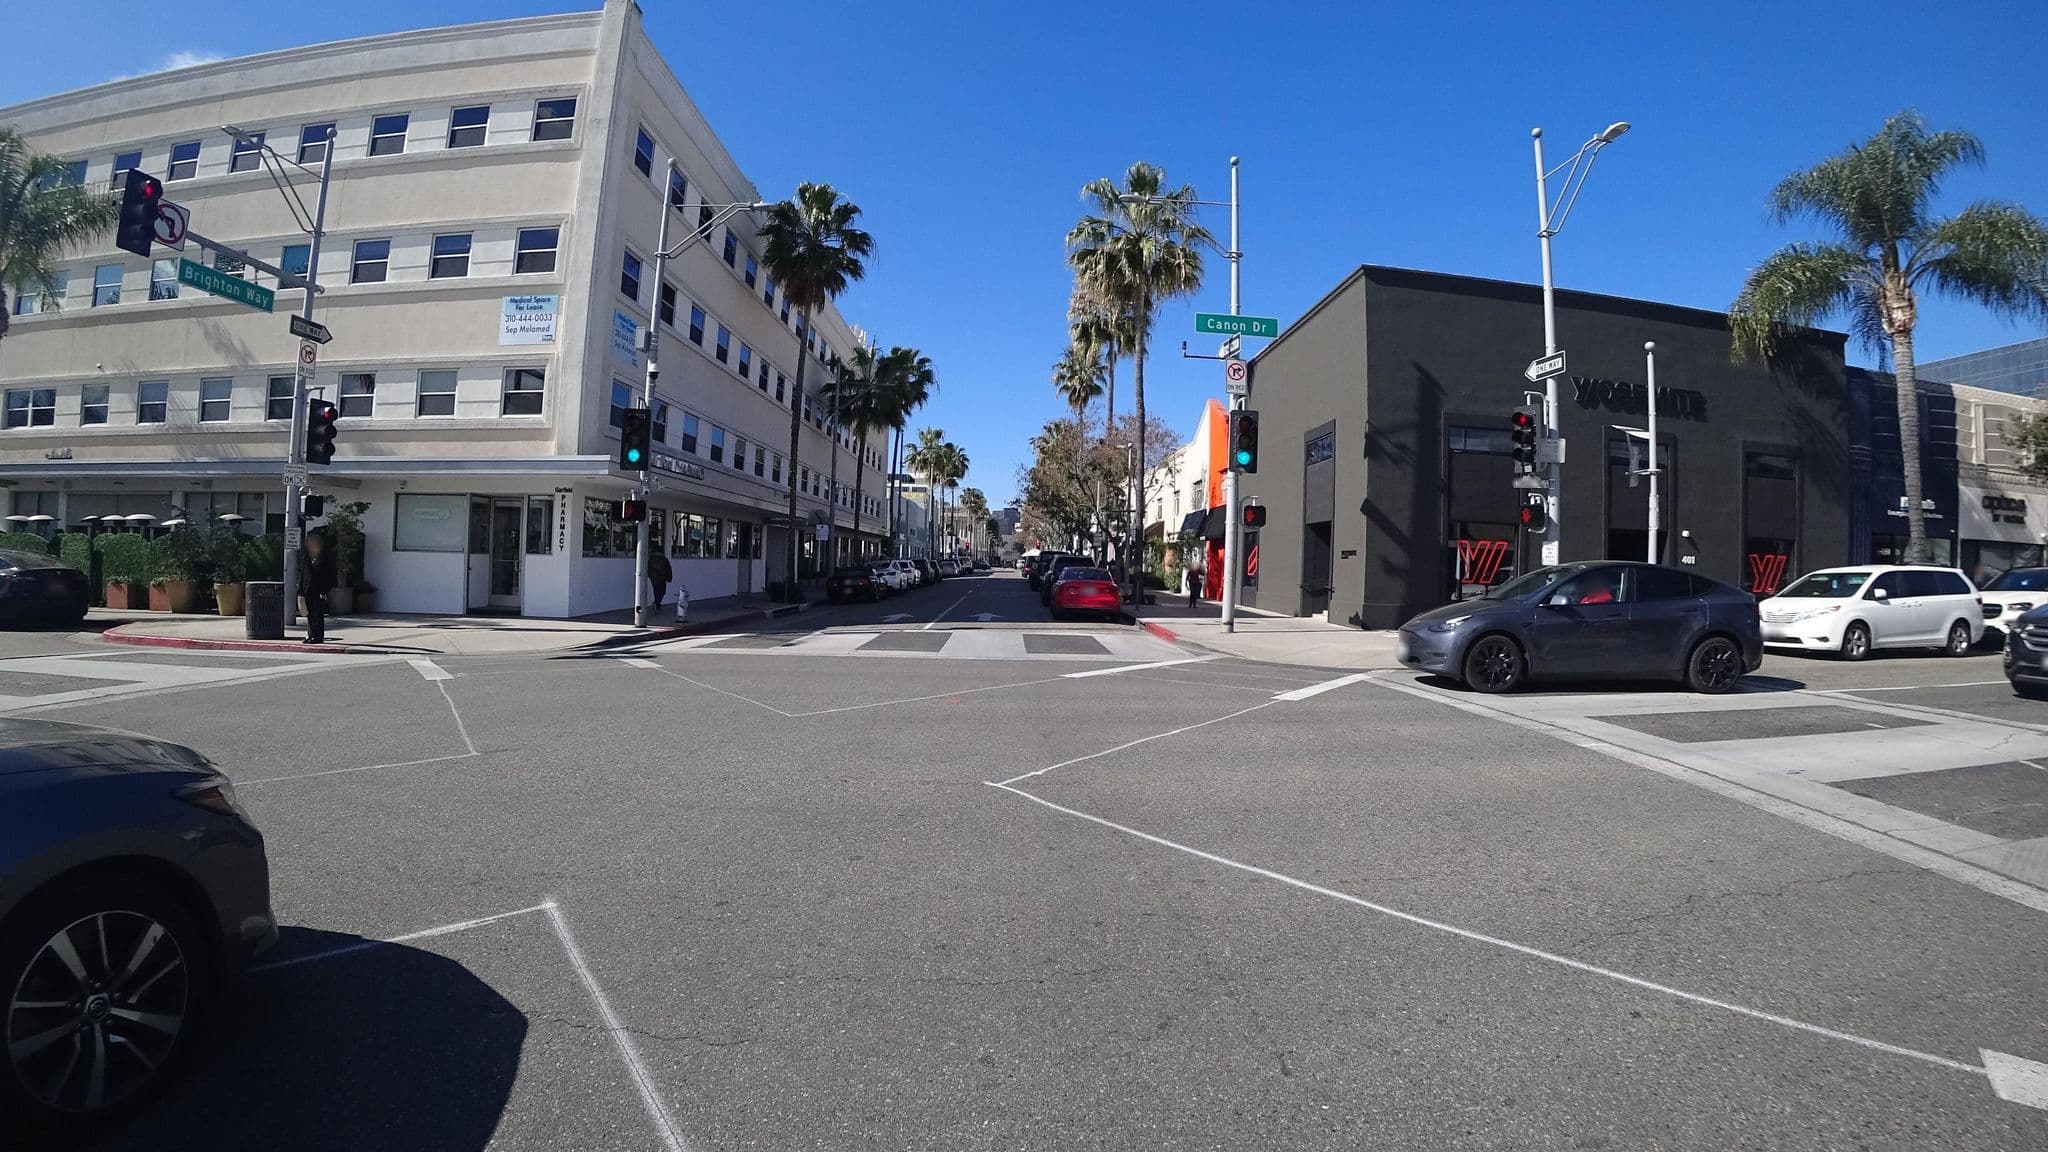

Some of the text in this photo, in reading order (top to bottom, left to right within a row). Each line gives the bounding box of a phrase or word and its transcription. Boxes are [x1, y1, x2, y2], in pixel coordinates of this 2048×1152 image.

[184, 265, 269, 308] Brighton Way
[533, 296, 551, 304] Space
[294, 322, 322, 337] ONE WAY
[505, 325, 518, 335] Sep
[1207, 318, 1267, 333] Canon Dr
[1536, 360, 1560, 373] ONE WAY
[284, 475, 294, 484] OK
[558, 494, 566, 551] PHARMACY
